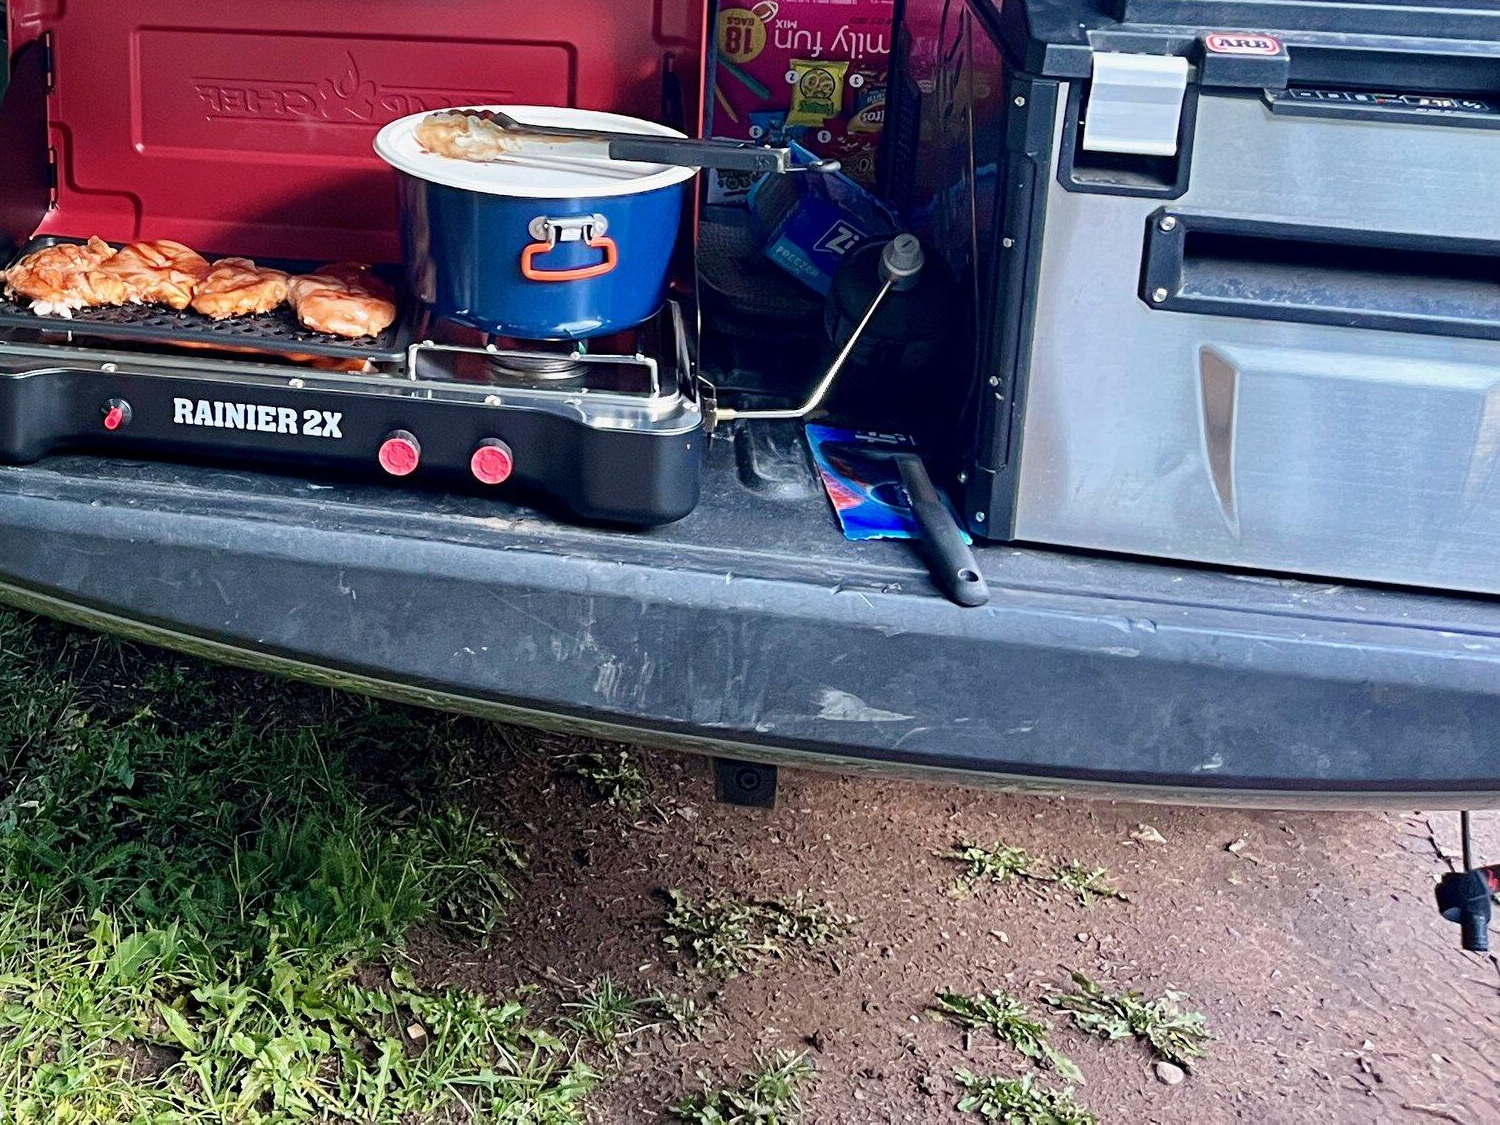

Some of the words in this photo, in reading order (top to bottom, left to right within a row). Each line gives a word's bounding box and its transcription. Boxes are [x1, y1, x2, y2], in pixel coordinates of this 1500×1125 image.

[727, 16, 755, 25] BAGS
[775, 19, 797, 28] MIX
[724, 26, 753, 55] 18
[775, 29, 823, 58] fun
[831, 25, 891, 59] mily
[1218, 38, 1269, 49] ARB
[833, 227, 860, 255] Zi
[173, 397, 298, 435] RAINIER
[302, 408, 343, 439] 2X
